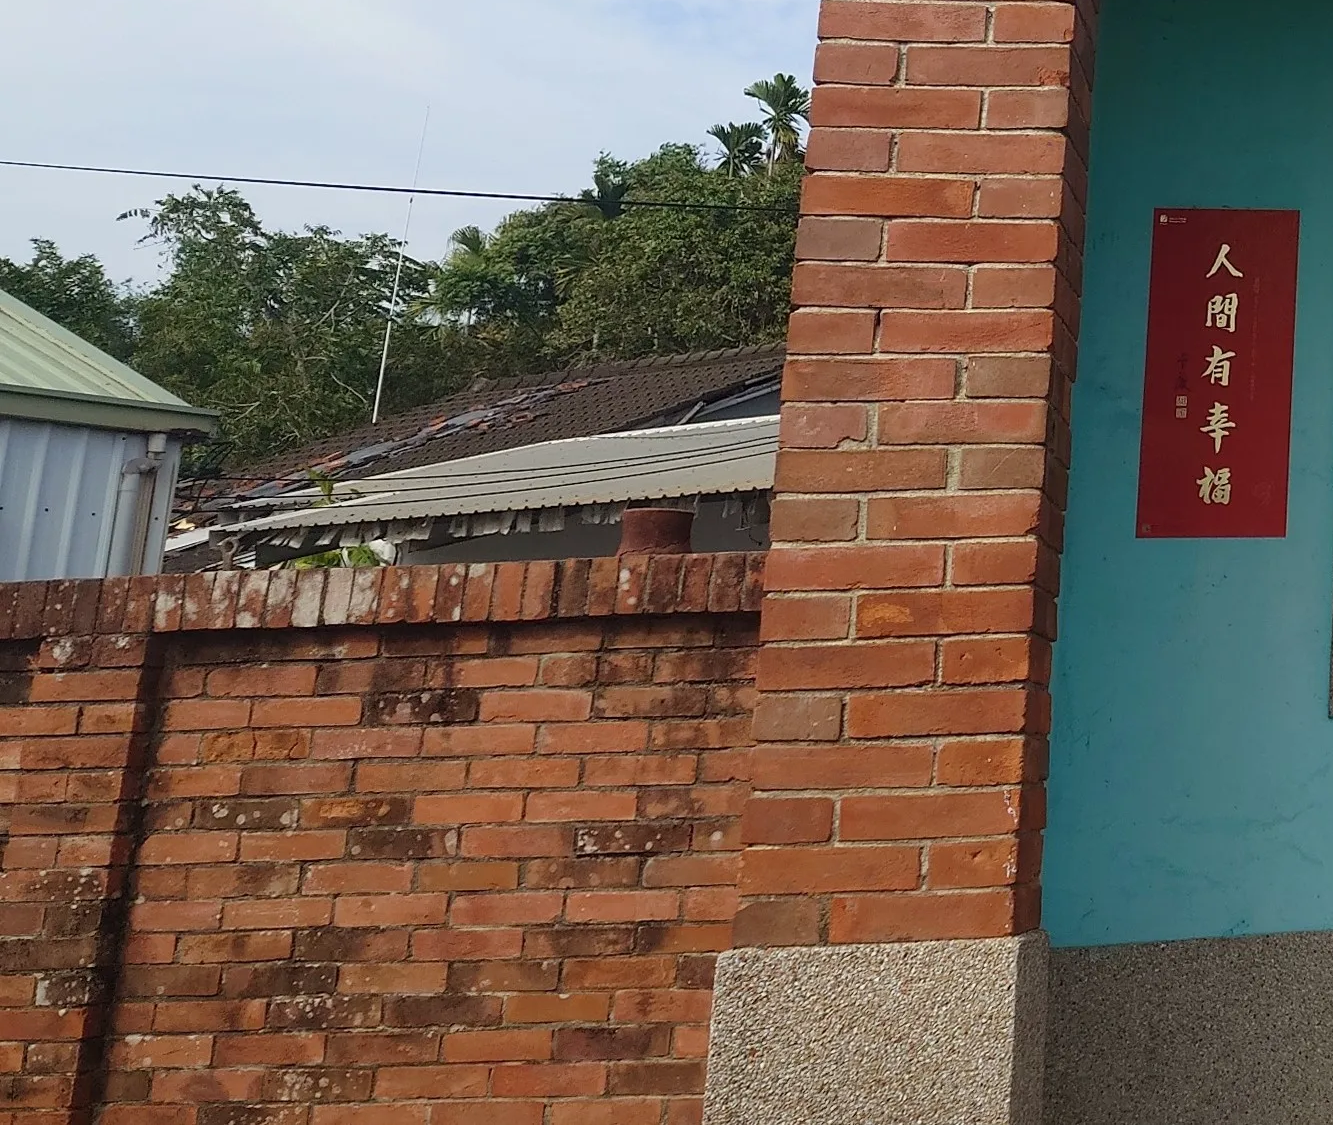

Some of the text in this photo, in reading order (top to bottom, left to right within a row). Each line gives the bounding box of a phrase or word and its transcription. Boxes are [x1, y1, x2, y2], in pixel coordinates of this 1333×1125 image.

[1196, 243, 1243, 506] 人間有幸福
